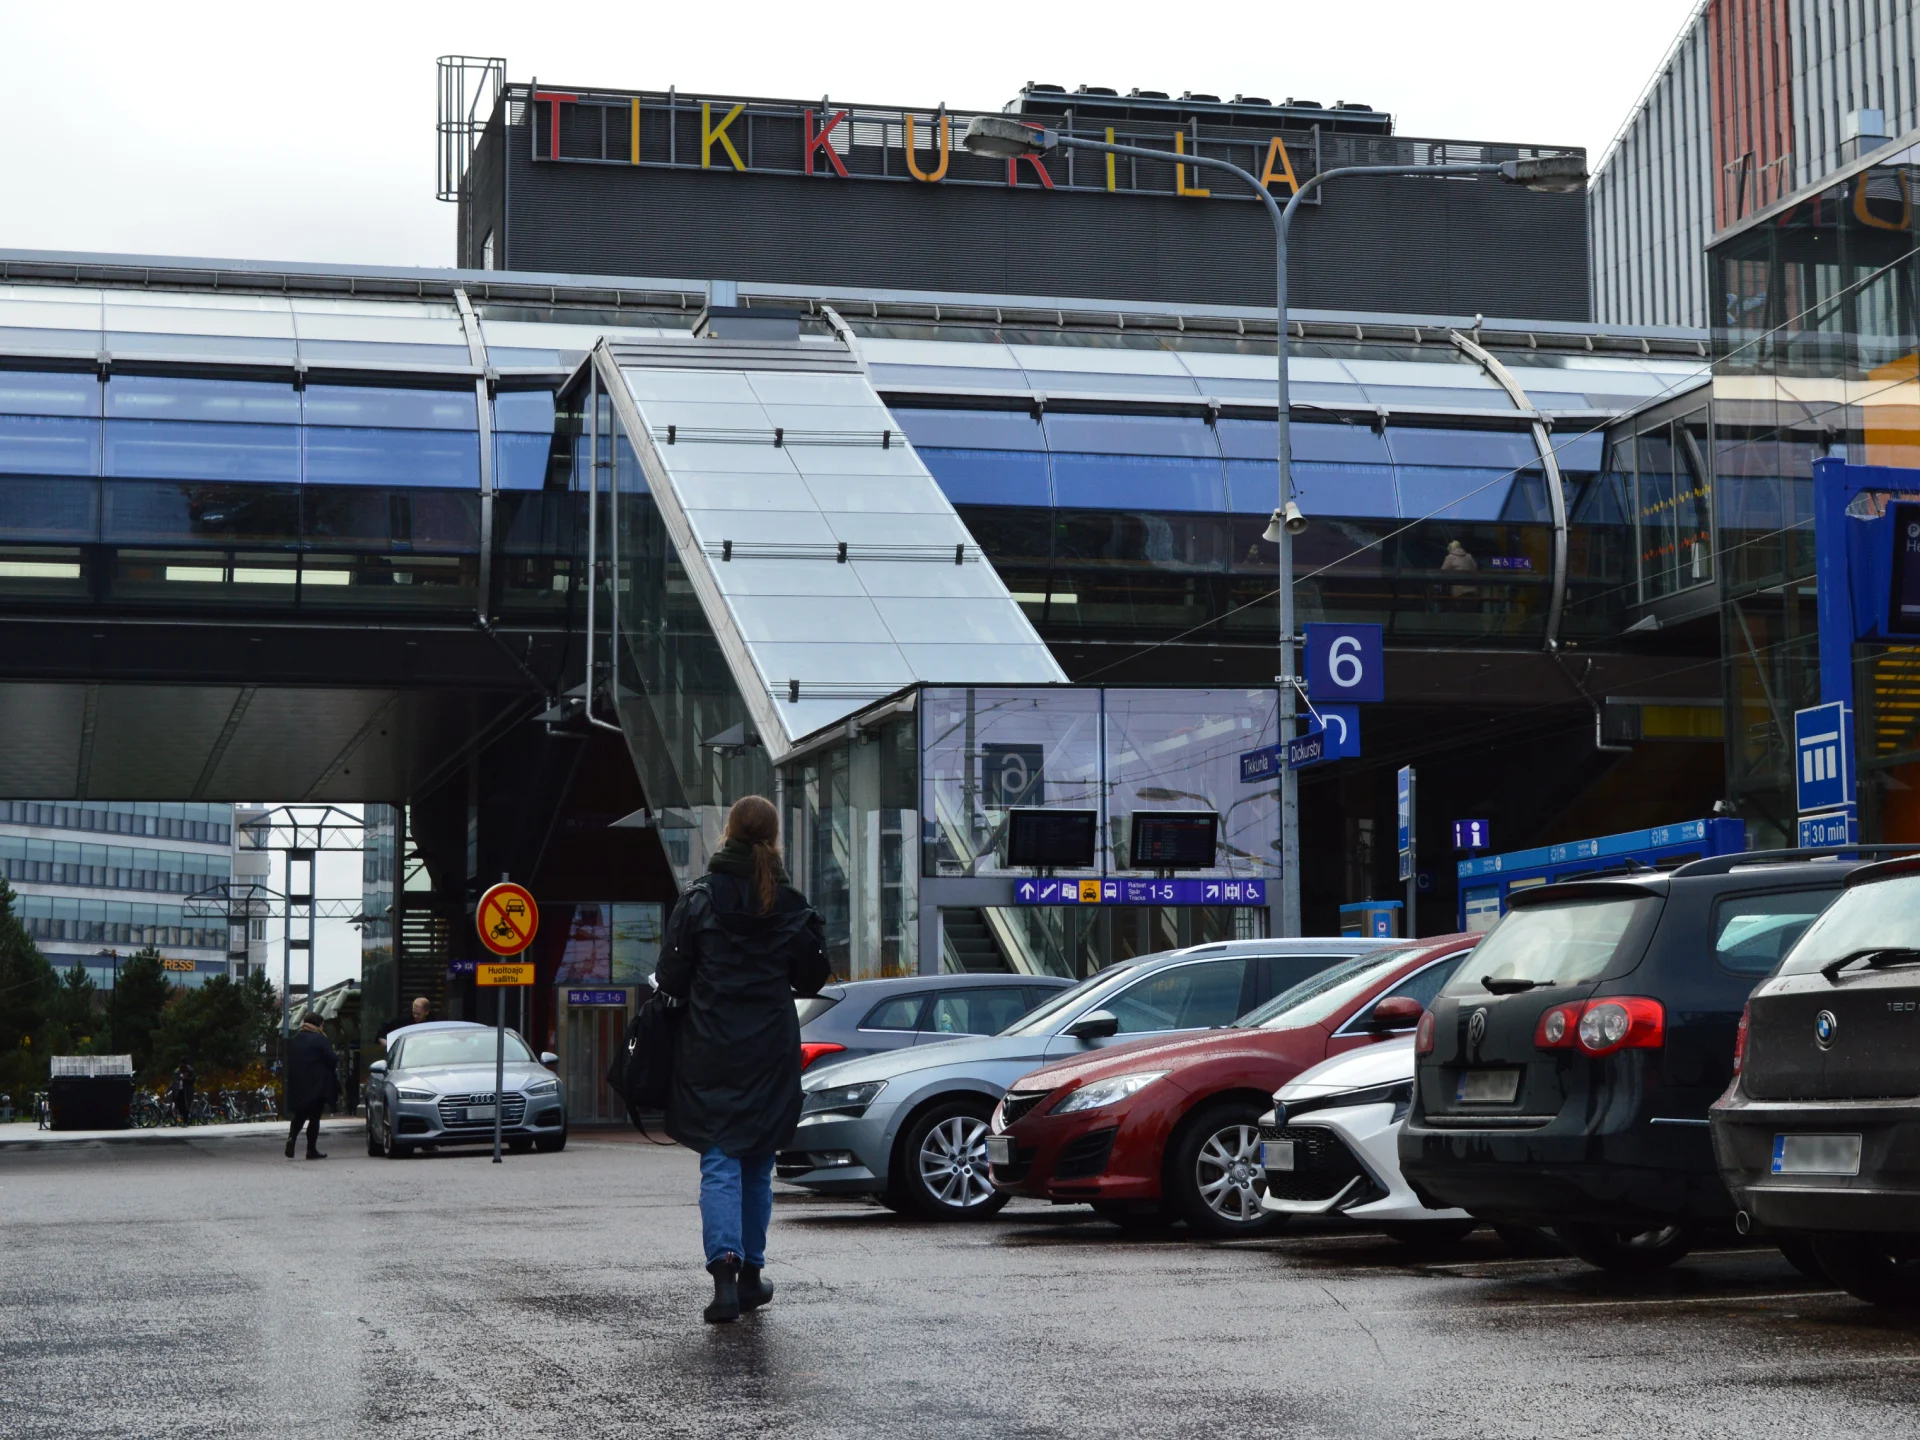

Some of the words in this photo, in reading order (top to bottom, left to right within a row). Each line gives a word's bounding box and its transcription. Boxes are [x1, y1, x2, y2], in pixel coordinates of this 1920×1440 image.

[1328, 635, 1363, 688] 6
[1812, 823, 1825, 844] 30
[1827, 821, 1845, 842] min
[1149, 884, 1174, 899] 1-5
[162, 958, 196, 971] RESSI
[487, 966, 524, 976] Huoltoajo
[493, 975, 518, 983] sallittu
[607, 993, 621, 1002] 1-5
